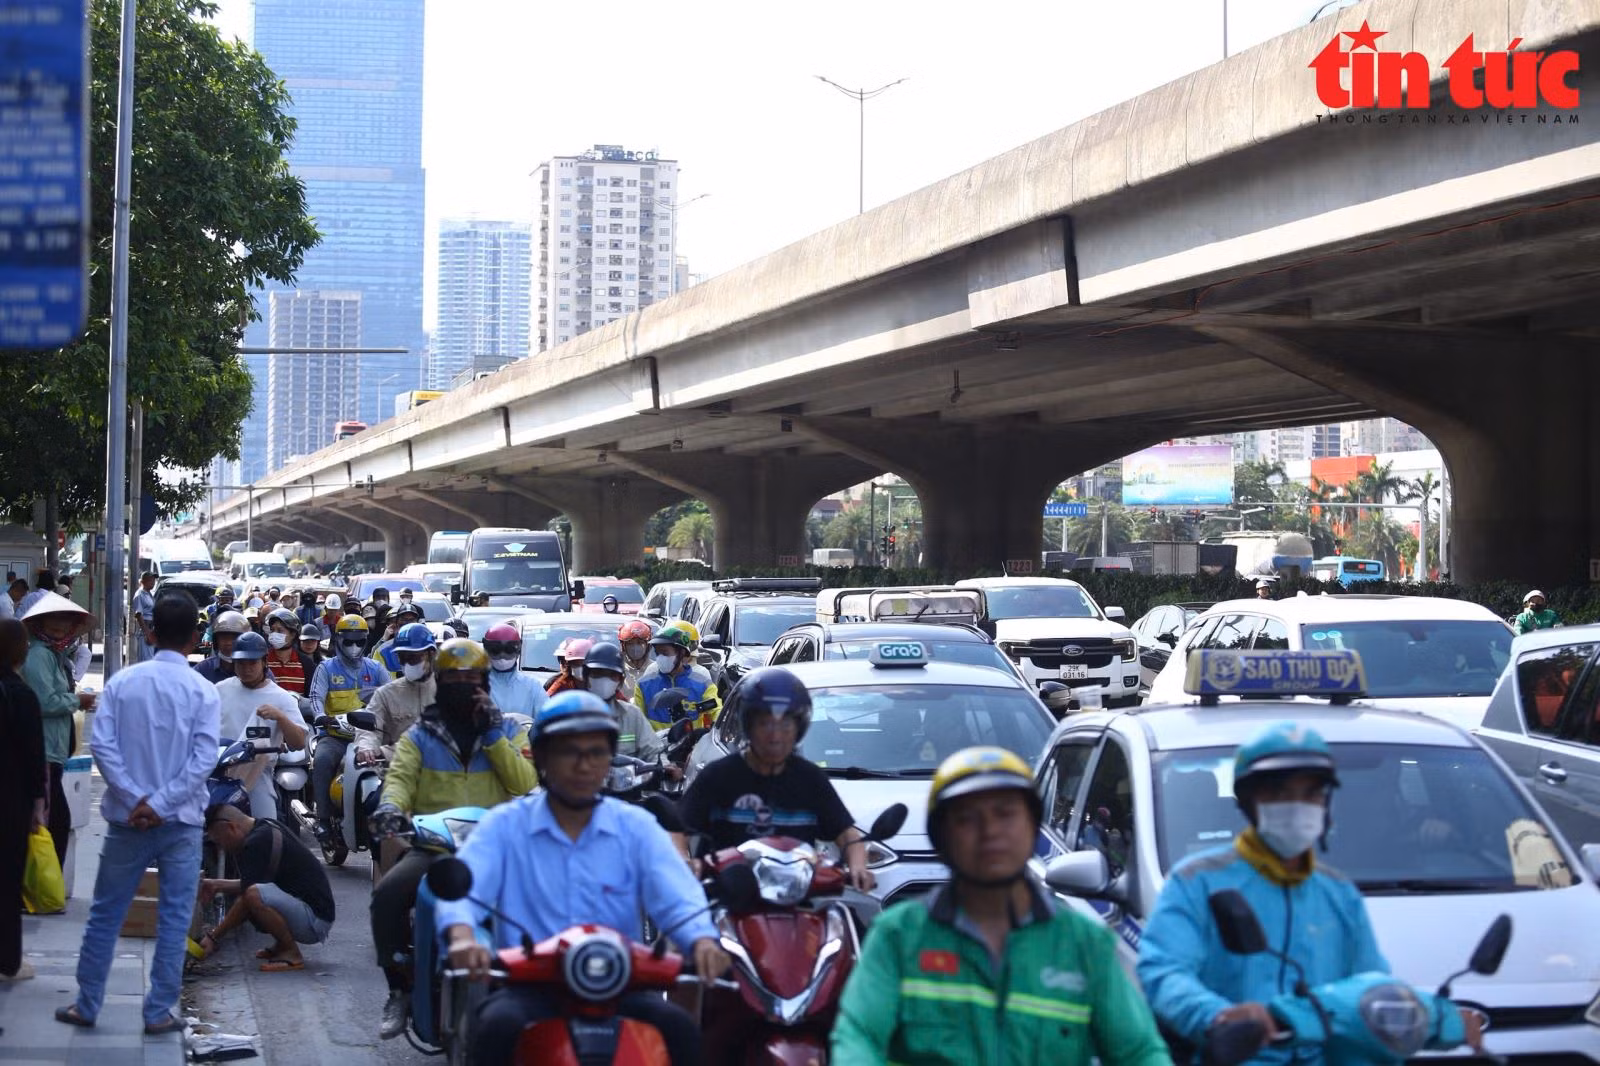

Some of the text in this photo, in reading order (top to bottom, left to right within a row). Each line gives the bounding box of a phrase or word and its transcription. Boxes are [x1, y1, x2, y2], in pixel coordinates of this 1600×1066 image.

[880, 644, 921, 657] Grab
[1246, 657, 1282, 680] SAO
[331, 672, 346, 685] be
